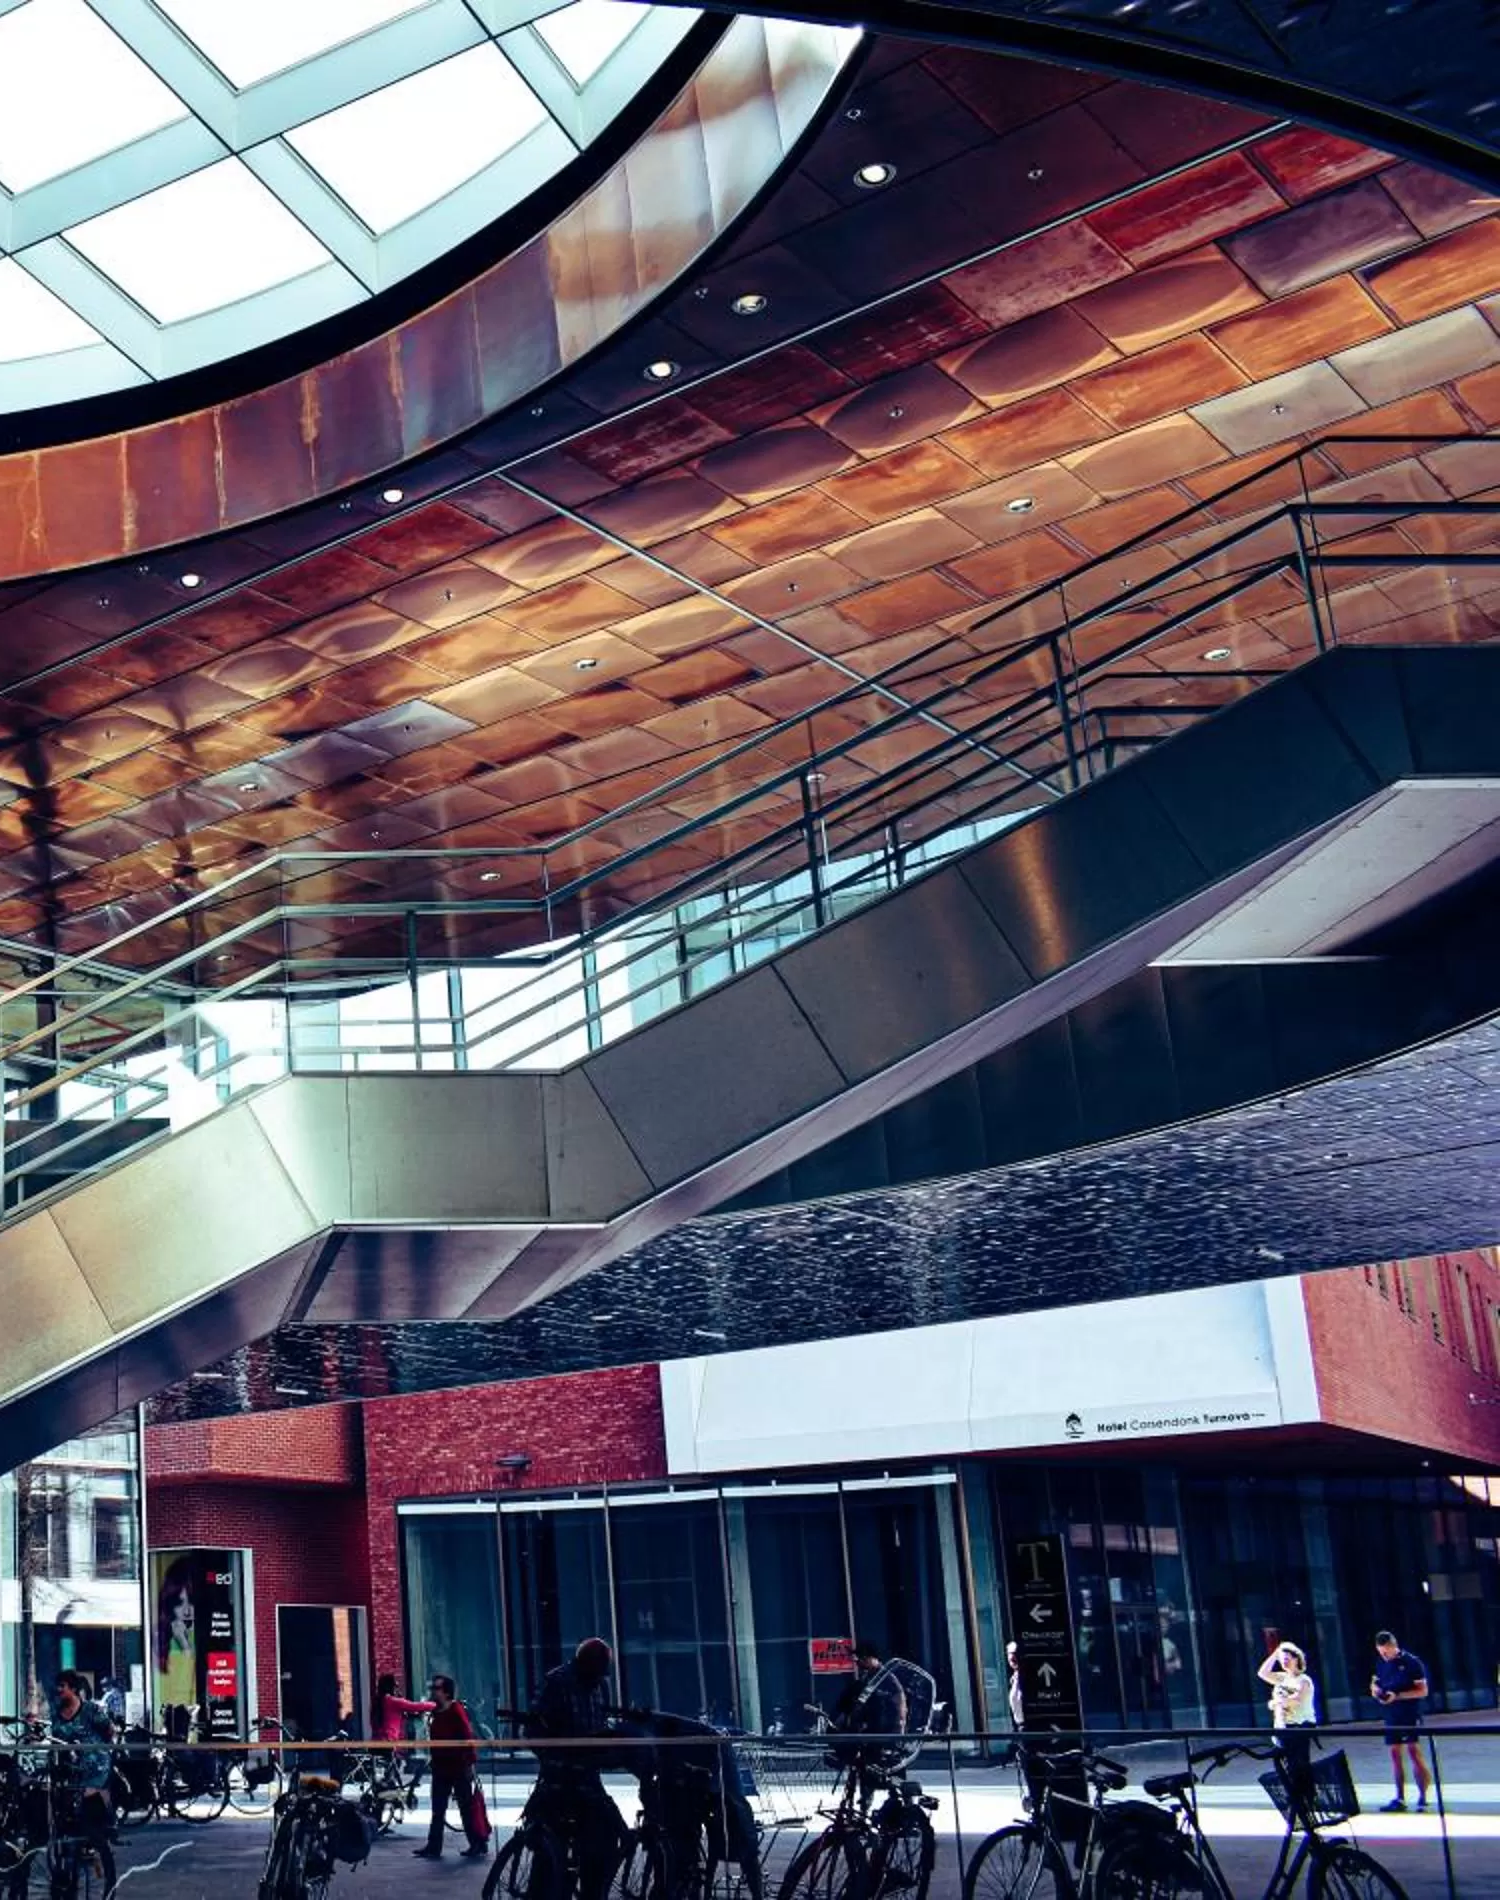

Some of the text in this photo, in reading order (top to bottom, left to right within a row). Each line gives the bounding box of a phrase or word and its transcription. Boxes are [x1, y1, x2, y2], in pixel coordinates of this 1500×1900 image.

[1097, 1421, 1127, 1433] Hotel
[1203, 1411, 1250, 1425] Turnova
[1016, 1541, 1050, 1582] T
